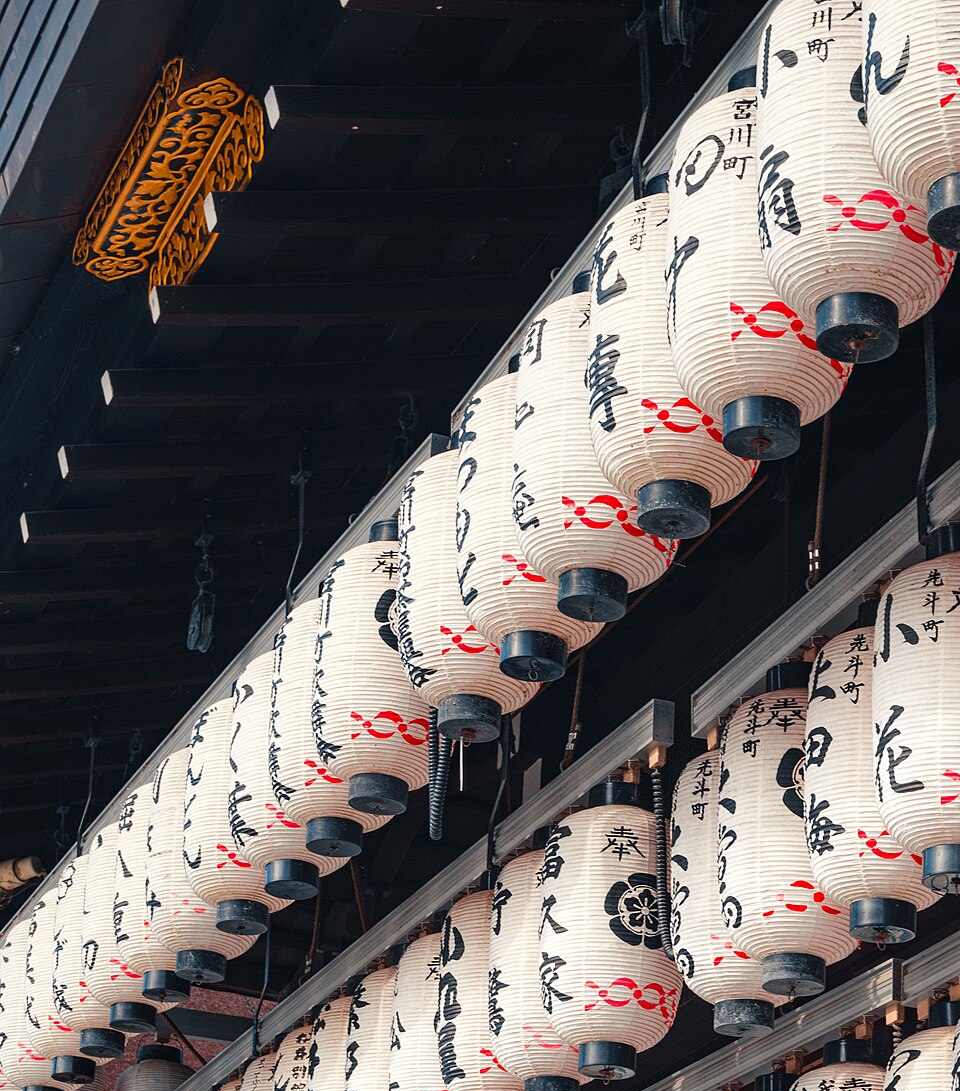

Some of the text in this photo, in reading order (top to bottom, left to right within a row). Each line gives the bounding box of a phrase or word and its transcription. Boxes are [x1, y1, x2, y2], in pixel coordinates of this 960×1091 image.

[807, 0, 833, 62] 川町
[722, 98, 756, 181] 宮川町
[921, 569, 944, 642] 先斗町
[840, 634, 868, 704] 先斗町
[742, 699, 765, 758] 先斗町
[691, 758, 713, 821] 先斗町
[600, 826, 646, 861] 奉
